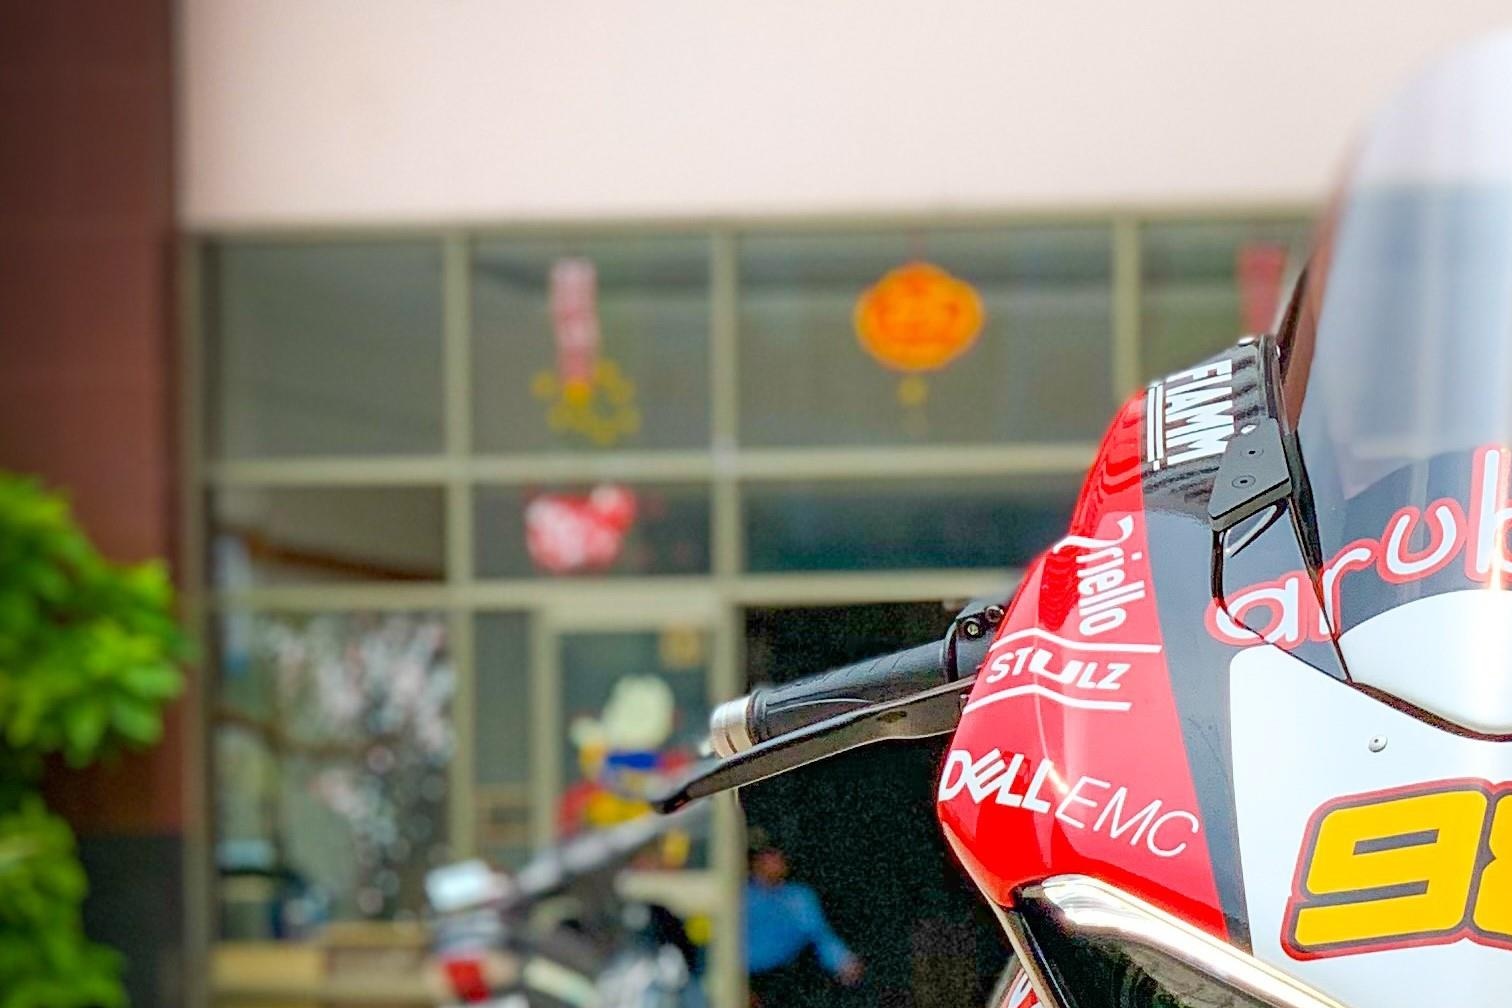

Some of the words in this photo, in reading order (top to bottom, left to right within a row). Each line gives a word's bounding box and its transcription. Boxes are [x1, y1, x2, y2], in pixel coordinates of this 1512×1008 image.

[1165, 358, 1235, 466] FIAMM
[985, 647, 1131, 690] STULZ
[939, 748, 1053, 814] DELL
[1055, 776, 1200, 857] EMC
